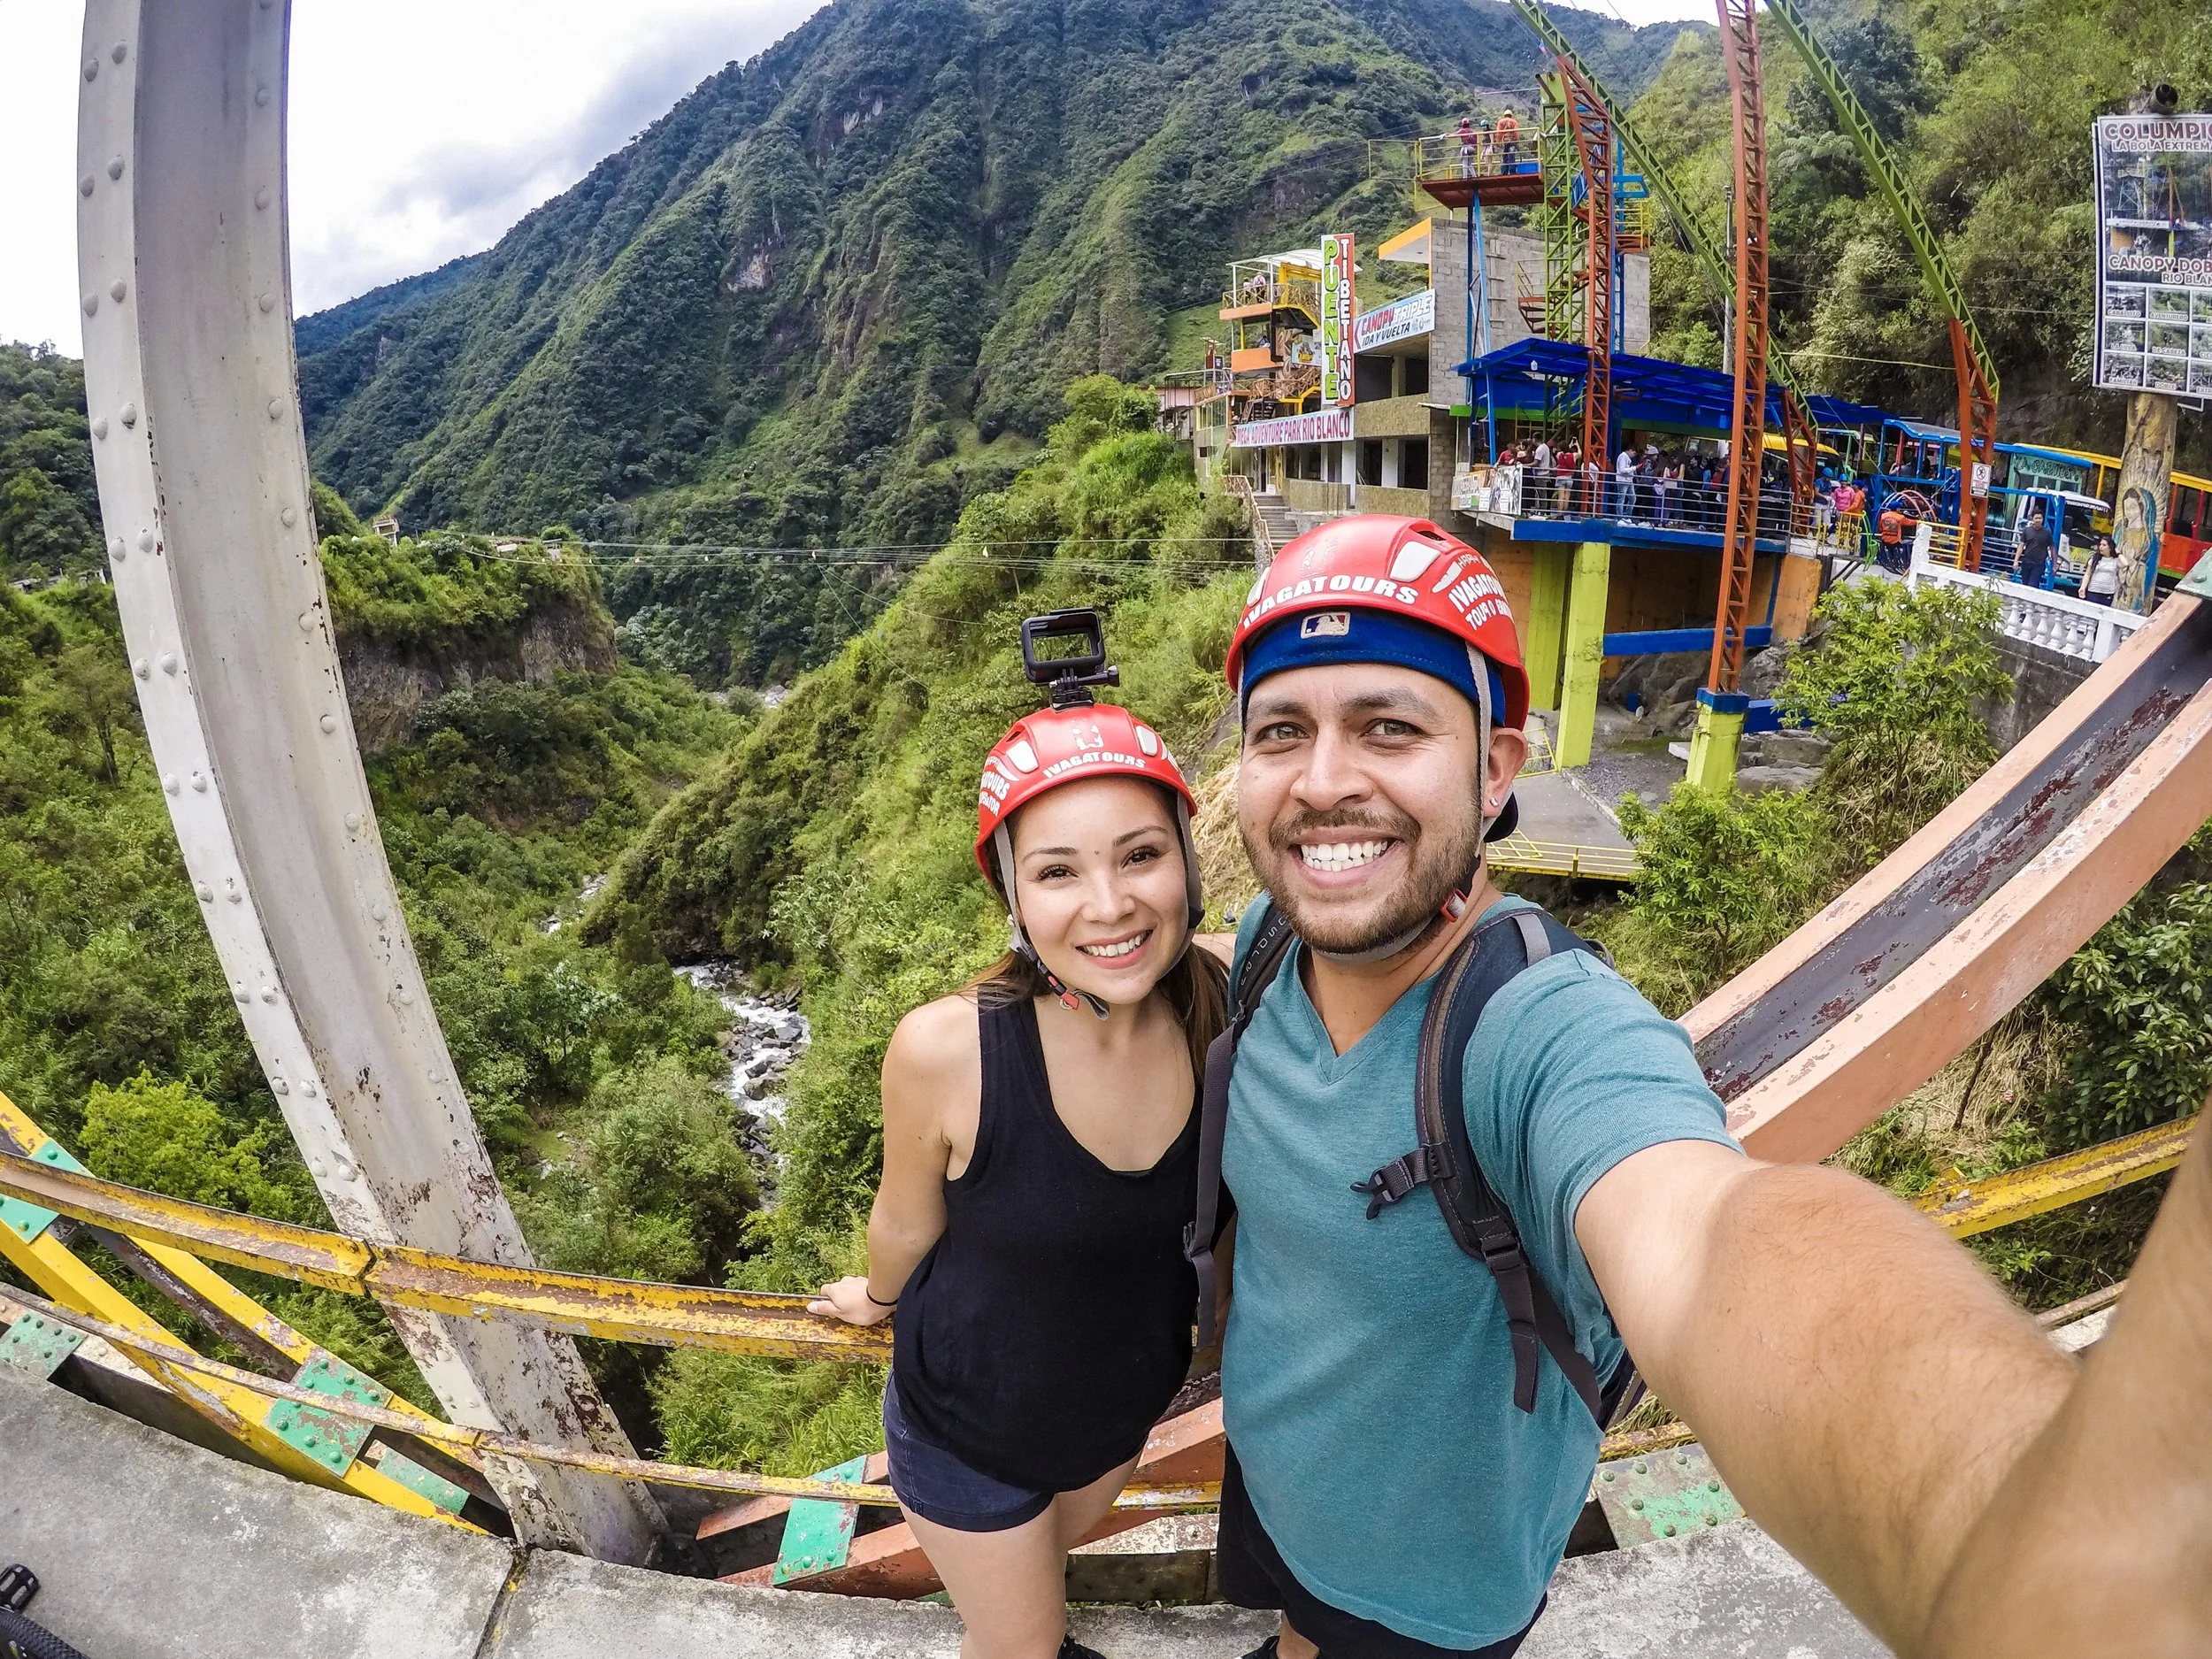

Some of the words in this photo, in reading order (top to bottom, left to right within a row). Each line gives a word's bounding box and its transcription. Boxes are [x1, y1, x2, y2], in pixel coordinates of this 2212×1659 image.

[2112, 141, 2128, 152] LA
[2130, 141, 2162, 152] BOLA
[2164, 141, 2212, 151] EXTREM
[2108, 255, 2176, 273] CANOPY
[2162, 272, 2183, 284] RIO
[1324, 239, 1339, 400] PUENTE
[1340, 238, 1352, 400] TIBETANO
[1361, 306, 1395, 336] CANOPY
[1394, 294, 1433, 325] TRIPLE
[1363, 336, 1374, 347] IDA
[1381, 321, 1410, 341] VUELTA
[1251, 421, 1284, 443] ADVENTURE
[1284, 417, 1302, 442] PARK
[1302, 416, 1315, 441] RIO
[1317, 411, 1350, 440] BLANCO
[1243, 574, 1419, 630] IVAGATOURS
[1042, 750, 1147, 780] IVAGATOURS
